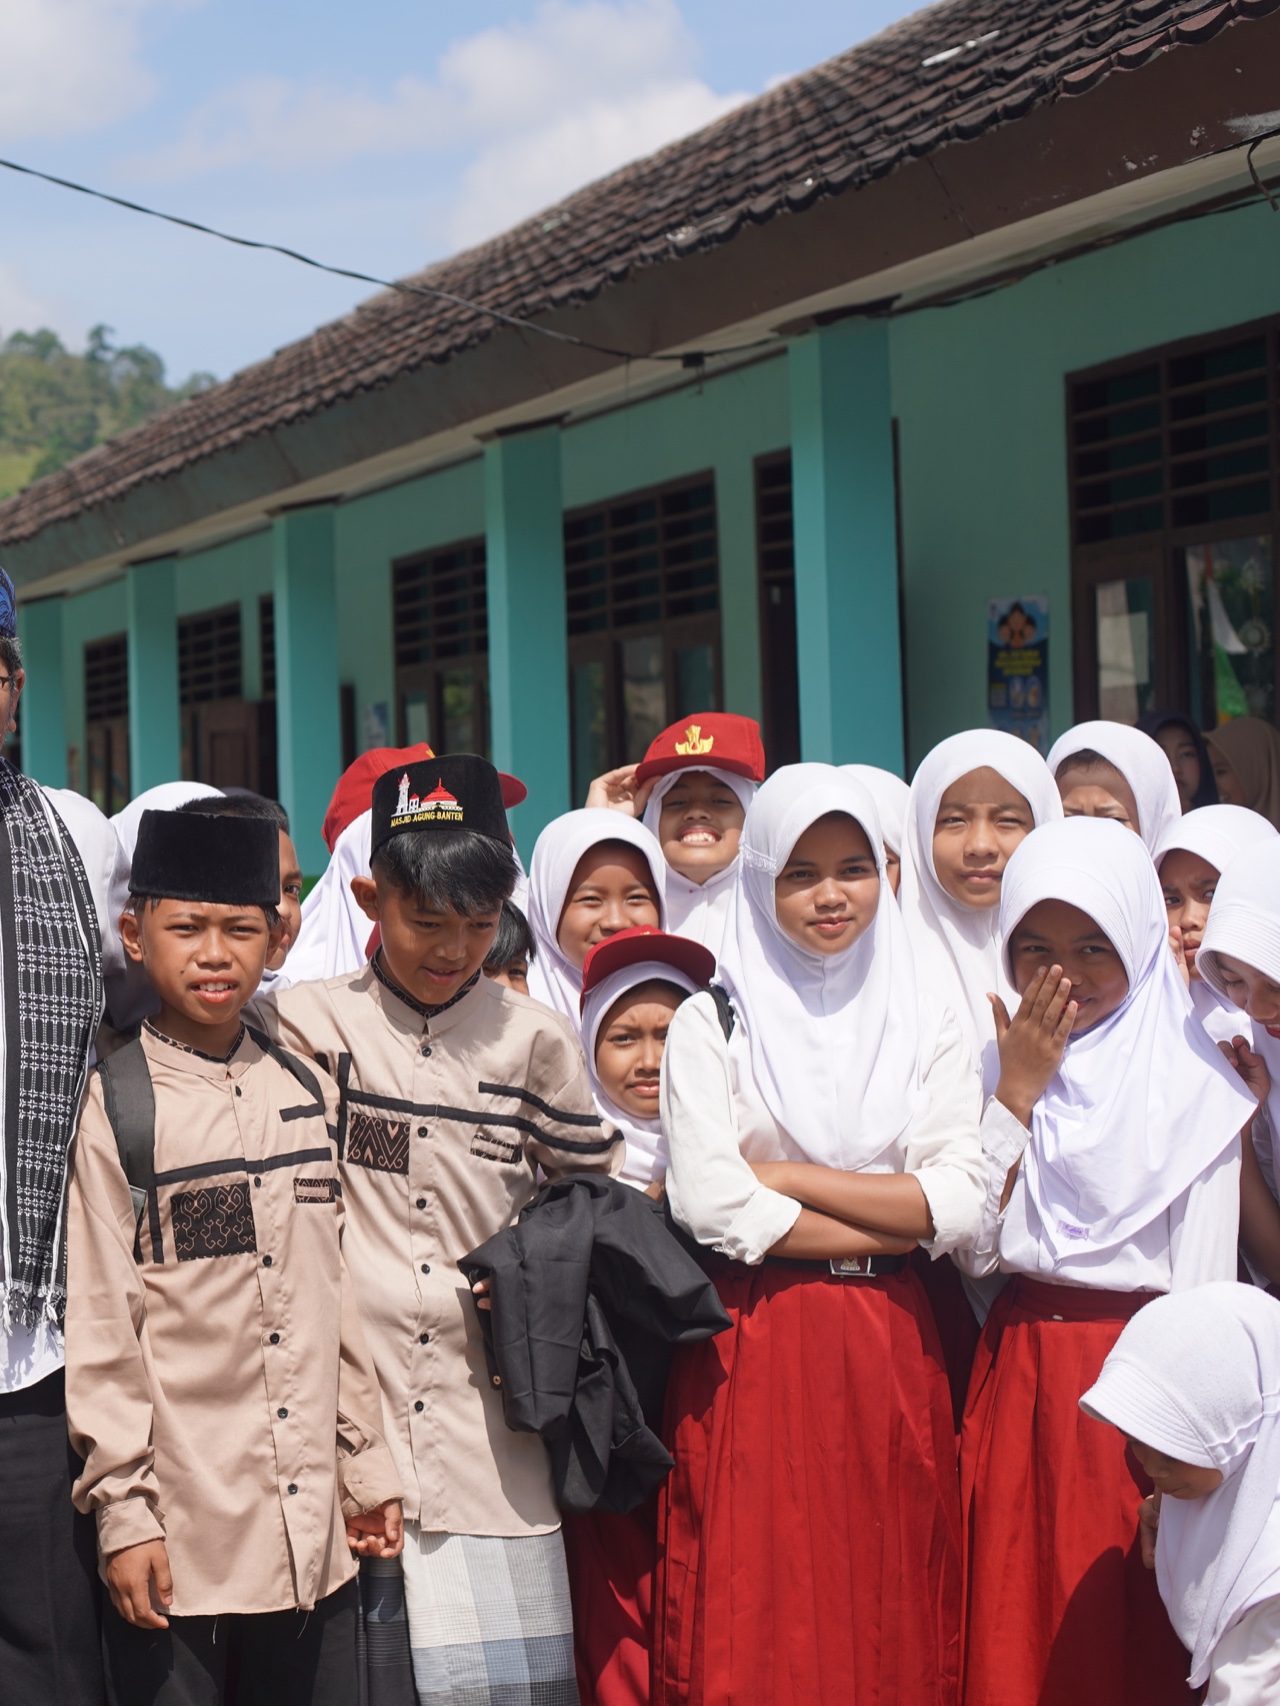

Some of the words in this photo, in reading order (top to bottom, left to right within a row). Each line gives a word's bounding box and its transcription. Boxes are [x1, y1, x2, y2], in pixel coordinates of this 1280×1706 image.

[390, 815, 412, 828] MASJID
[413, 812, 436, 822] AGUNG
[437, 811, 463, 822] BANTEN
